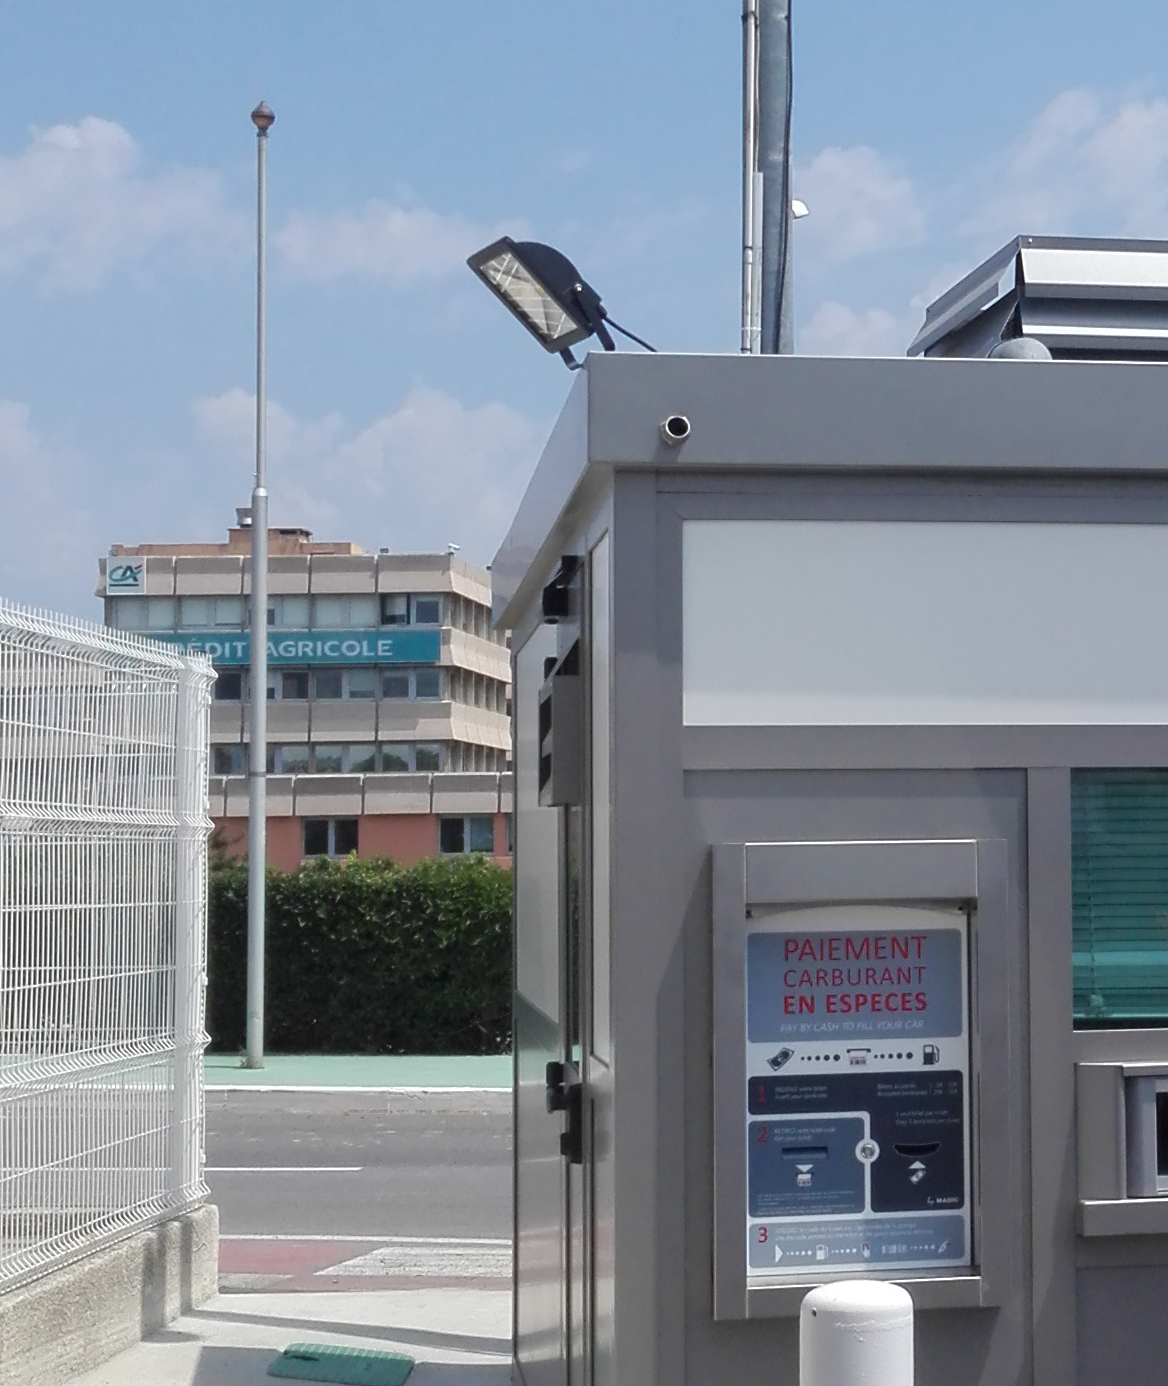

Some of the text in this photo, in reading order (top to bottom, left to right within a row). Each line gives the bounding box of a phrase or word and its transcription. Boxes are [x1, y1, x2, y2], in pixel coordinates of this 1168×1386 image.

[266, 640, 393, 658] AGRICOLE
[784, 936, 928, 961] PAIEMENT
[784, 966, 927, 988] CARBURANT
[783, 992, 928, 1015] EN ESPECES
[780, 1020, 925, 1032] PAY BY CASH TO FILL YOUR CAR
[757, 1127, 768, 1143] 2
[758, 1227, 769, 1244] 3
